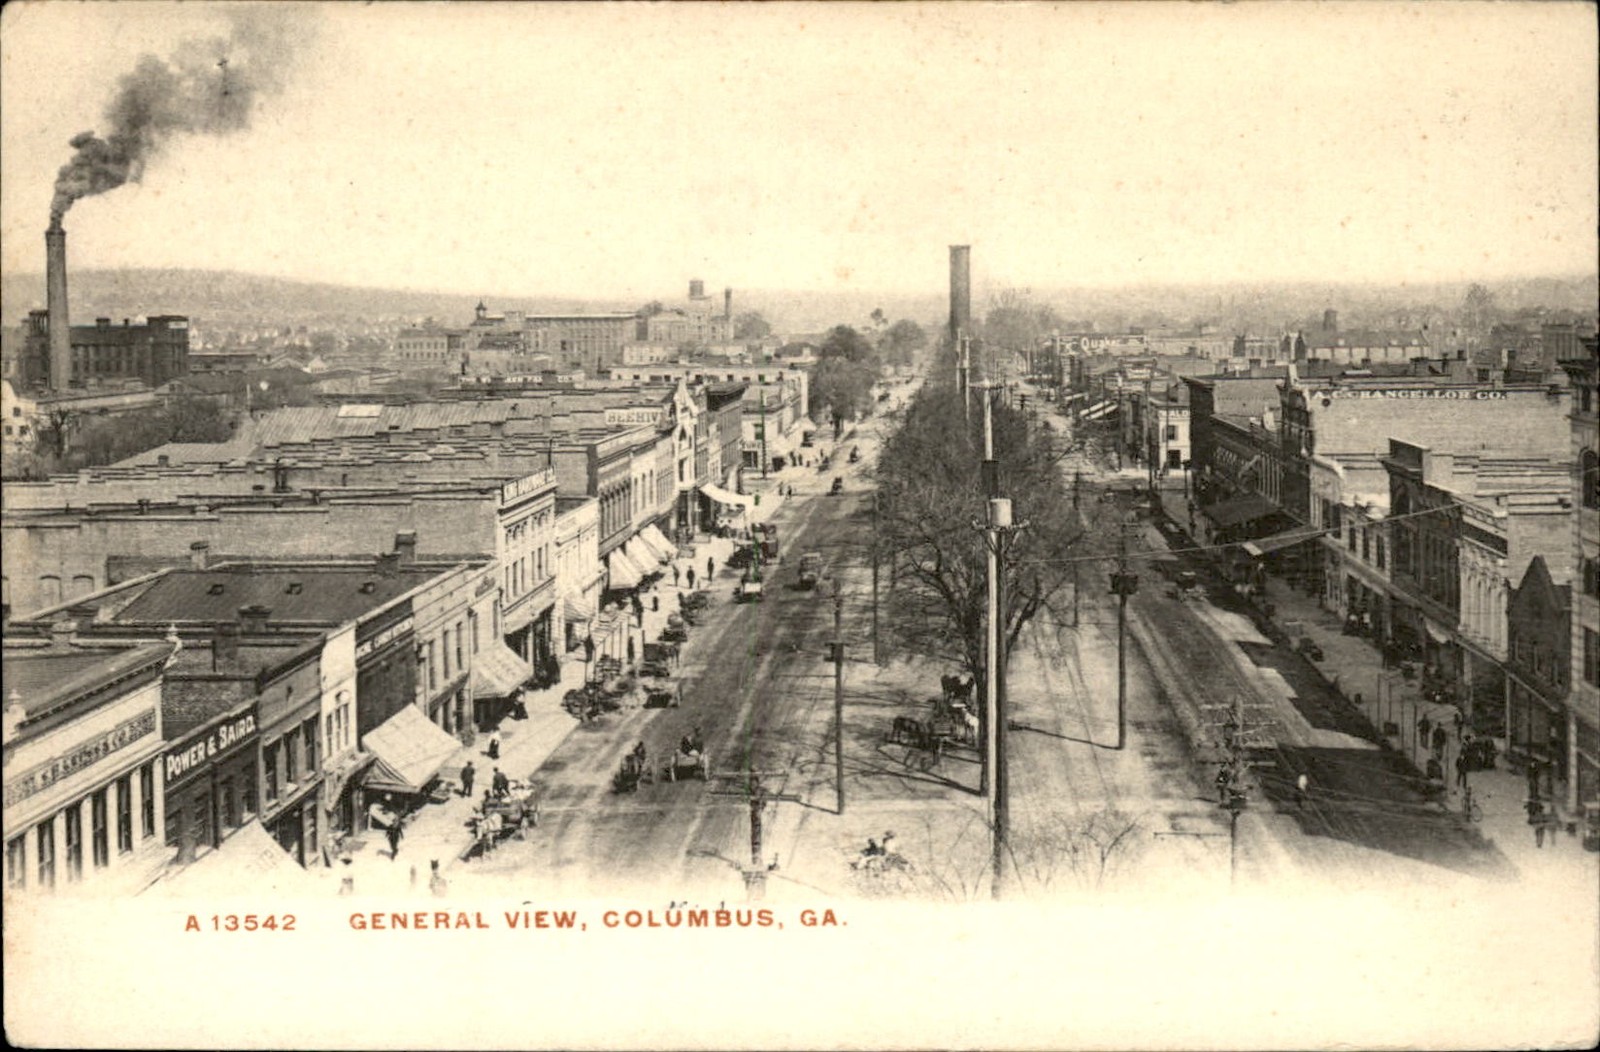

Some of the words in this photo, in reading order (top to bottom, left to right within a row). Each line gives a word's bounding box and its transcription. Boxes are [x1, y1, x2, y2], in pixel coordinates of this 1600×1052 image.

[1348, 389, 1470, 400] CHANCELLOR
[1476, 390, 1506, 400] CO.
[607, 411, 666, 423] BEEHIV
[167, 741, 206, 781] POWER
[207, 735, 217, 757] &
